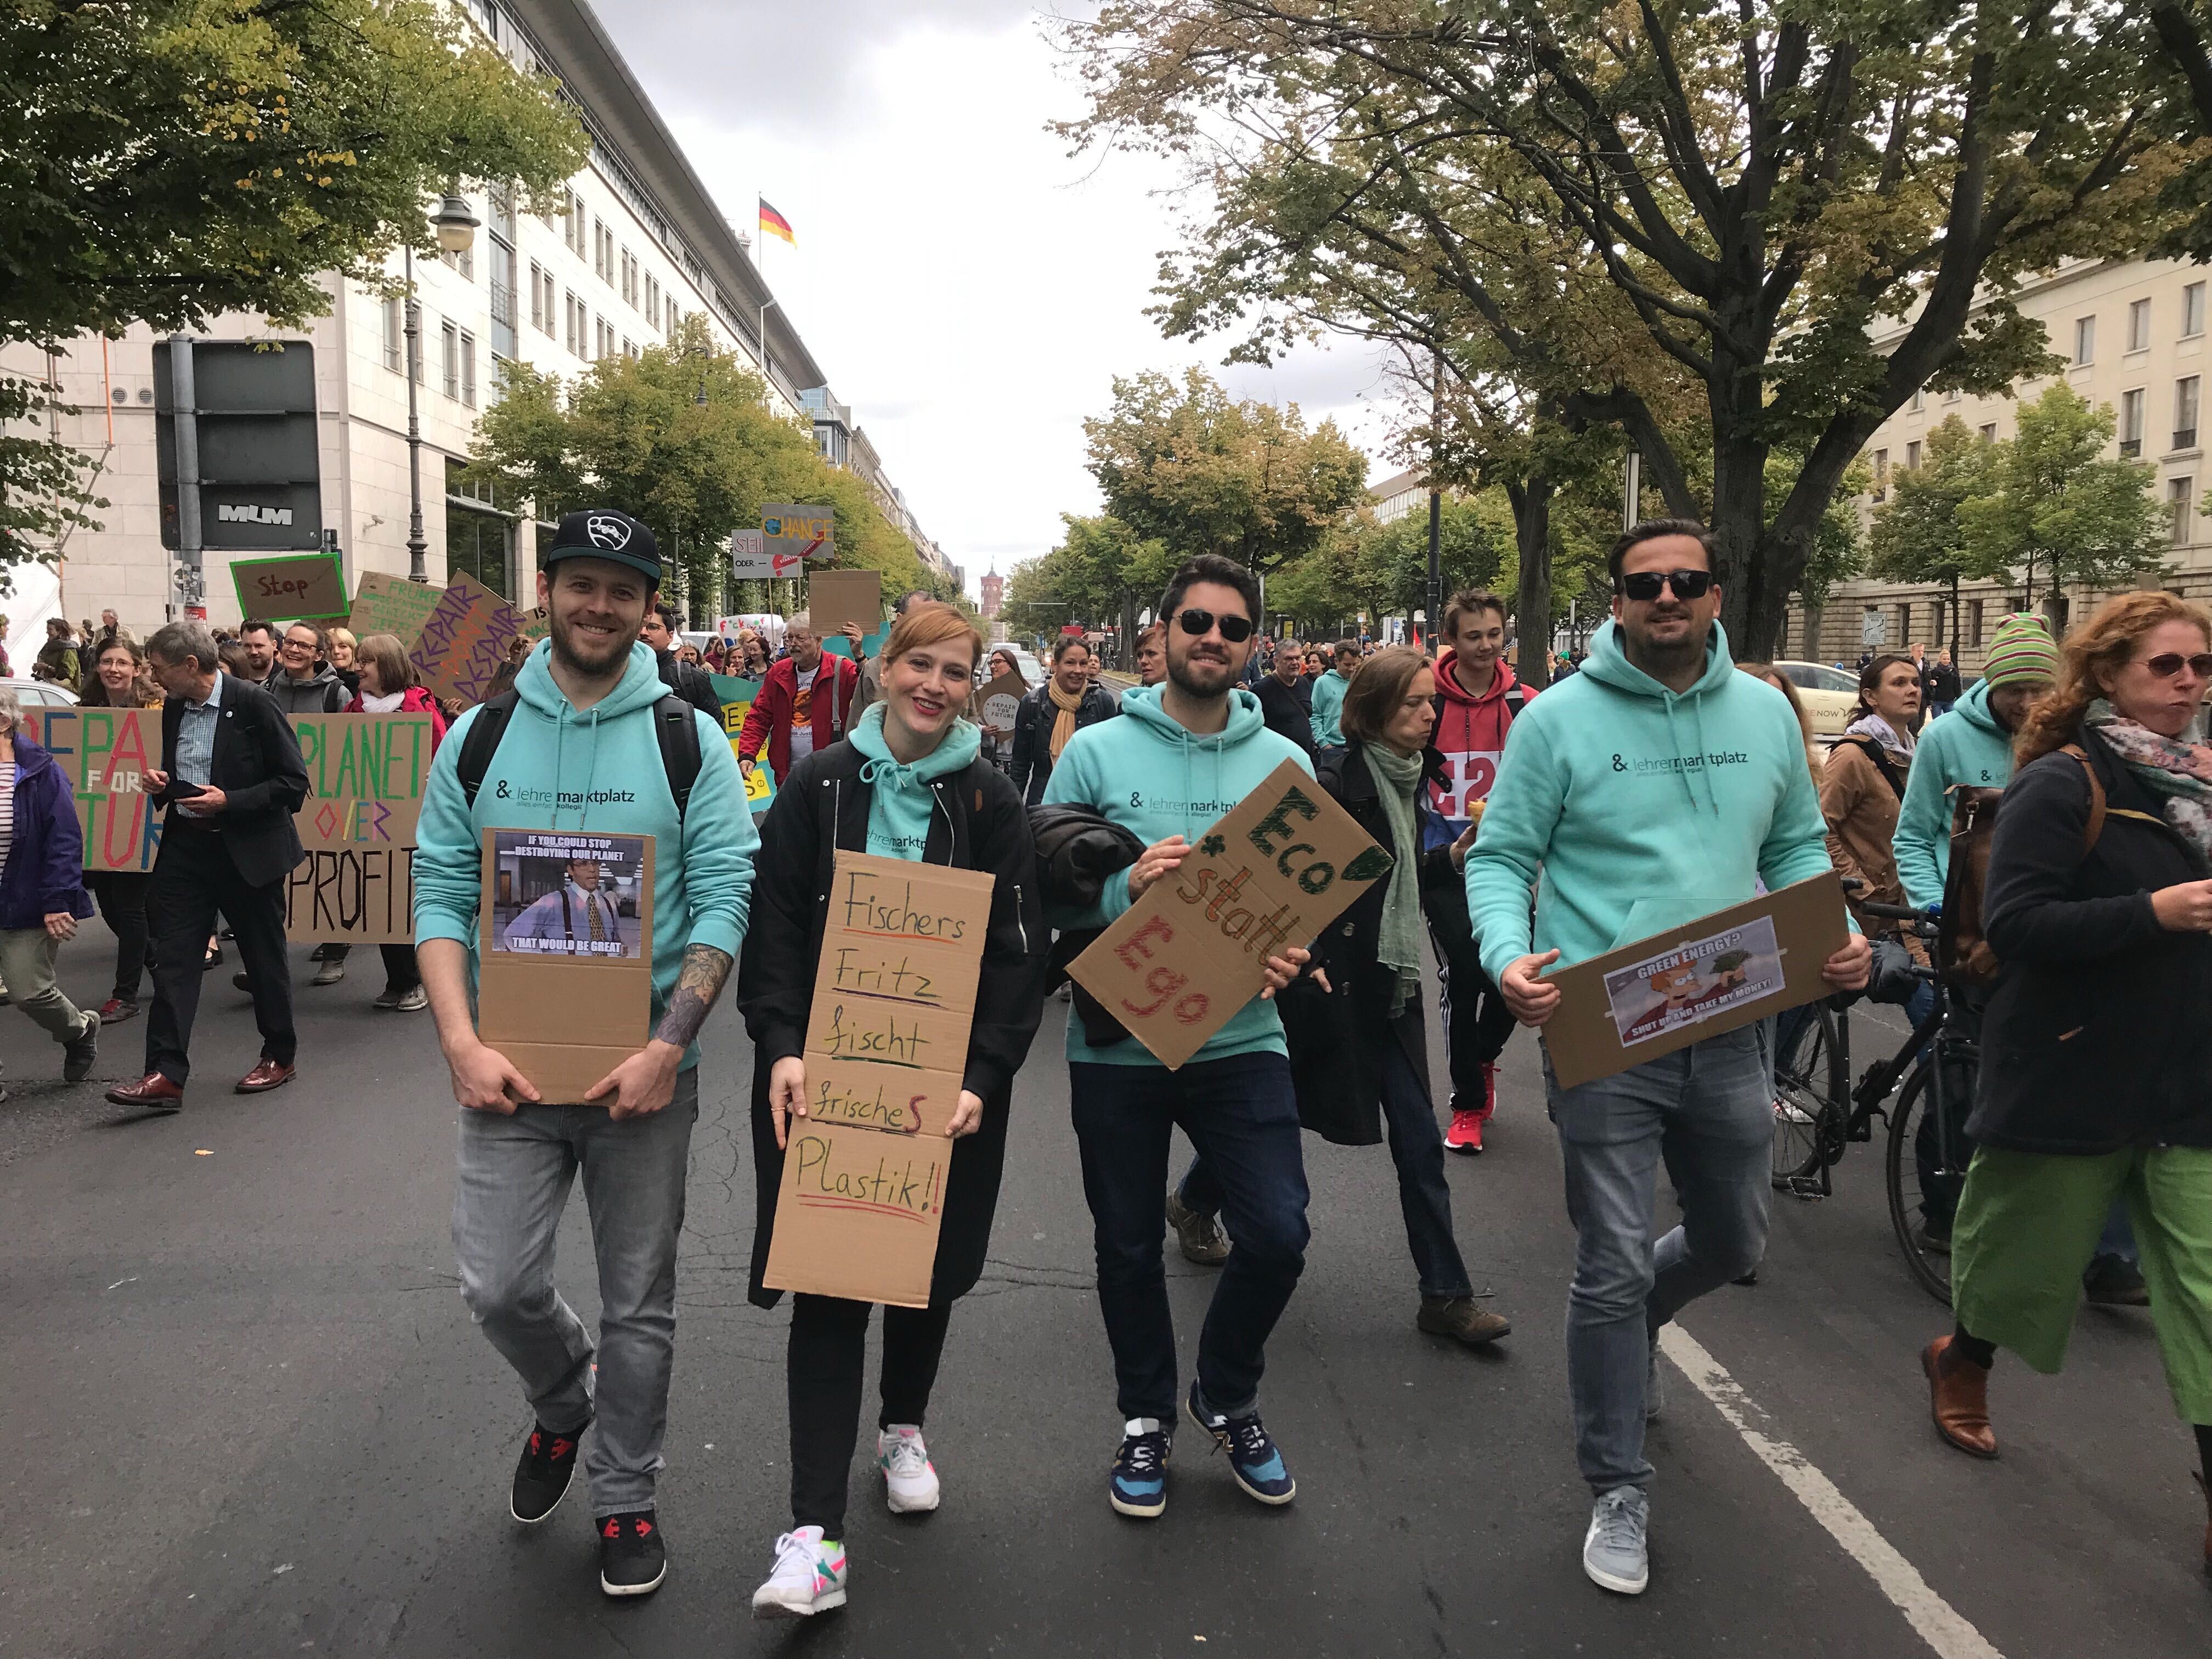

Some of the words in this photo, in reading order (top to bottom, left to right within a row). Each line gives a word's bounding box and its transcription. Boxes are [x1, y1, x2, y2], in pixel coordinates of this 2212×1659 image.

[219, 504, 292, 526] MLM
[761, 516, 834, 541] CHANGE
[258, 574, 308, 599] Stop
[409, 585, 483, 676] REPAIR
[453, 607, 527, 703] DESPAIR
[87, 769, 143, 793] FOR
[297, 721, 429, 799] PLANET
[314, 799, 392, 843] OVER
[528, 835, 538, 845] IF
[538, 836, 556, 846] YOU
[557, 837, 587, 848] COULD
[588, 838, 612, 849] STOP
[1247, 785, 1336, 894] Eco
[515, 846, 571, 859] DESTROYING
[572, 849, 590, 859] OUR
[592, 850, 624, 861] PLANET
[288, 847, 419, 935] PROFIT
[845, 872, 967, 939] Fischers
[512, 937, 537, 949] THAT
[539, 938, 575, 950] WOULD
[577, 940, 589, 951] BE
[591, 941, 622, 952] GREAT
[1637, 953, 1680, 979] GREEN
[1681, 931, 1742, 961] ENERGY?
[835, 949, 943, 997] Fritz
[1113, 915, 1210, 1025] Ego
[1632, 1021, 1660, 1036] SHUT
[1658, 1014, 1672, 1026] UP
[1673, 1008, 1693, 1020] AND
[1695, 998, 1717, 1012] TAKE
[1718, 993, 1734, 1005] MY
[1735, 978, 1773, 998] MONEY!
[824, 1005, 932, 1061] fischt
